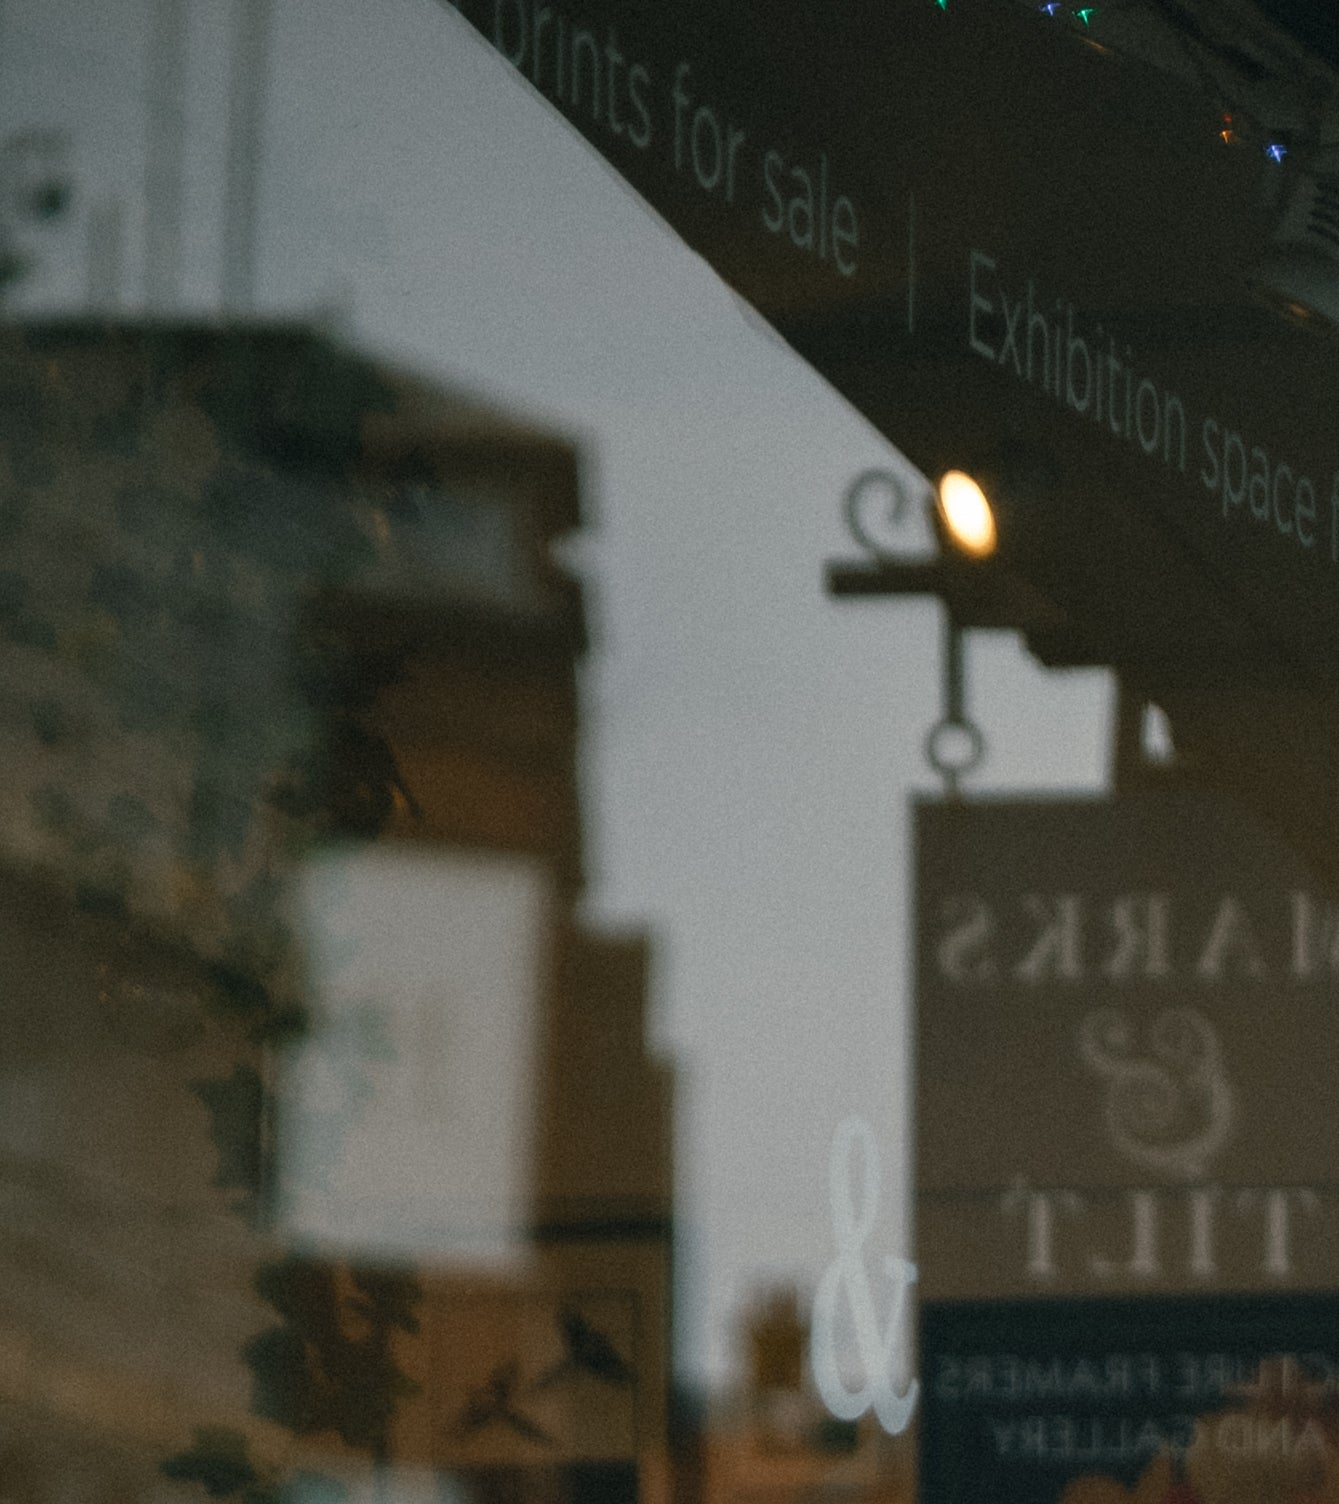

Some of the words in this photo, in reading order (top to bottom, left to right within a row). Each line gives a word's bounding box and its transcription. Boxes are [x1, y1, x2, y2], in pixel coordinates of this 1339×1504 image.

[671, 62, 746, 202] for
[763, 148, 859, 277] sale
[969, 248, 1190, 474] Exhibition
[1201, 412, 1317, 558] space
